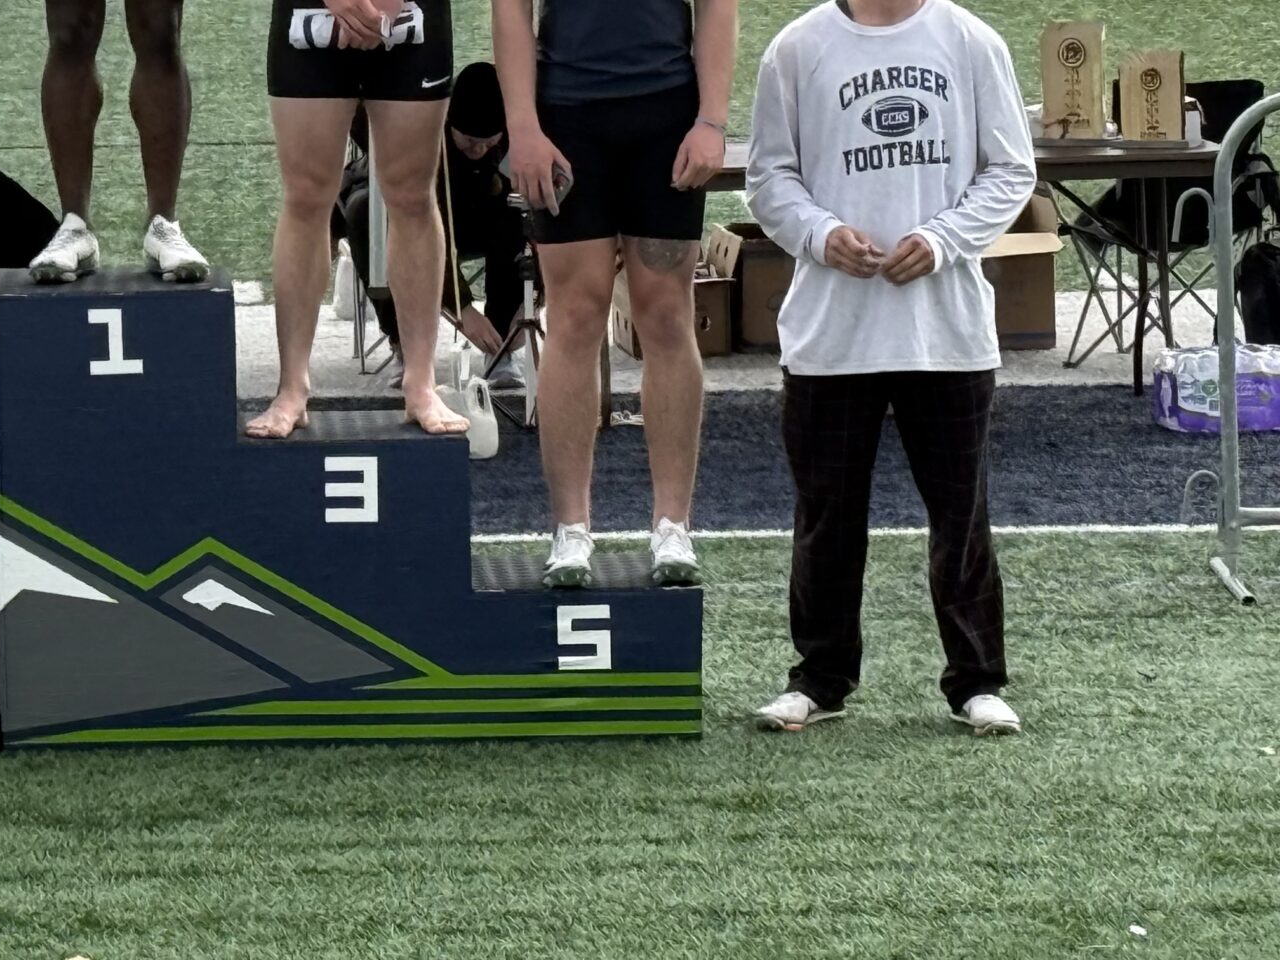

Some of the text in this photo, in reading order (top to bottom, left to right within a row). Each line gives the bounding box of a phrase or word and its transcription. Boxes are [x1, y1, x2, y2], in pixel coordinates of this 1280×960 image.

[839, 66, 949, 111] CHARGER
[842, 139, 951, 176] FOOTBALL
[88, 309, 143, 375] 1
[324, 456, 379, 523] 3
[557, 604, 612, 670] 5
